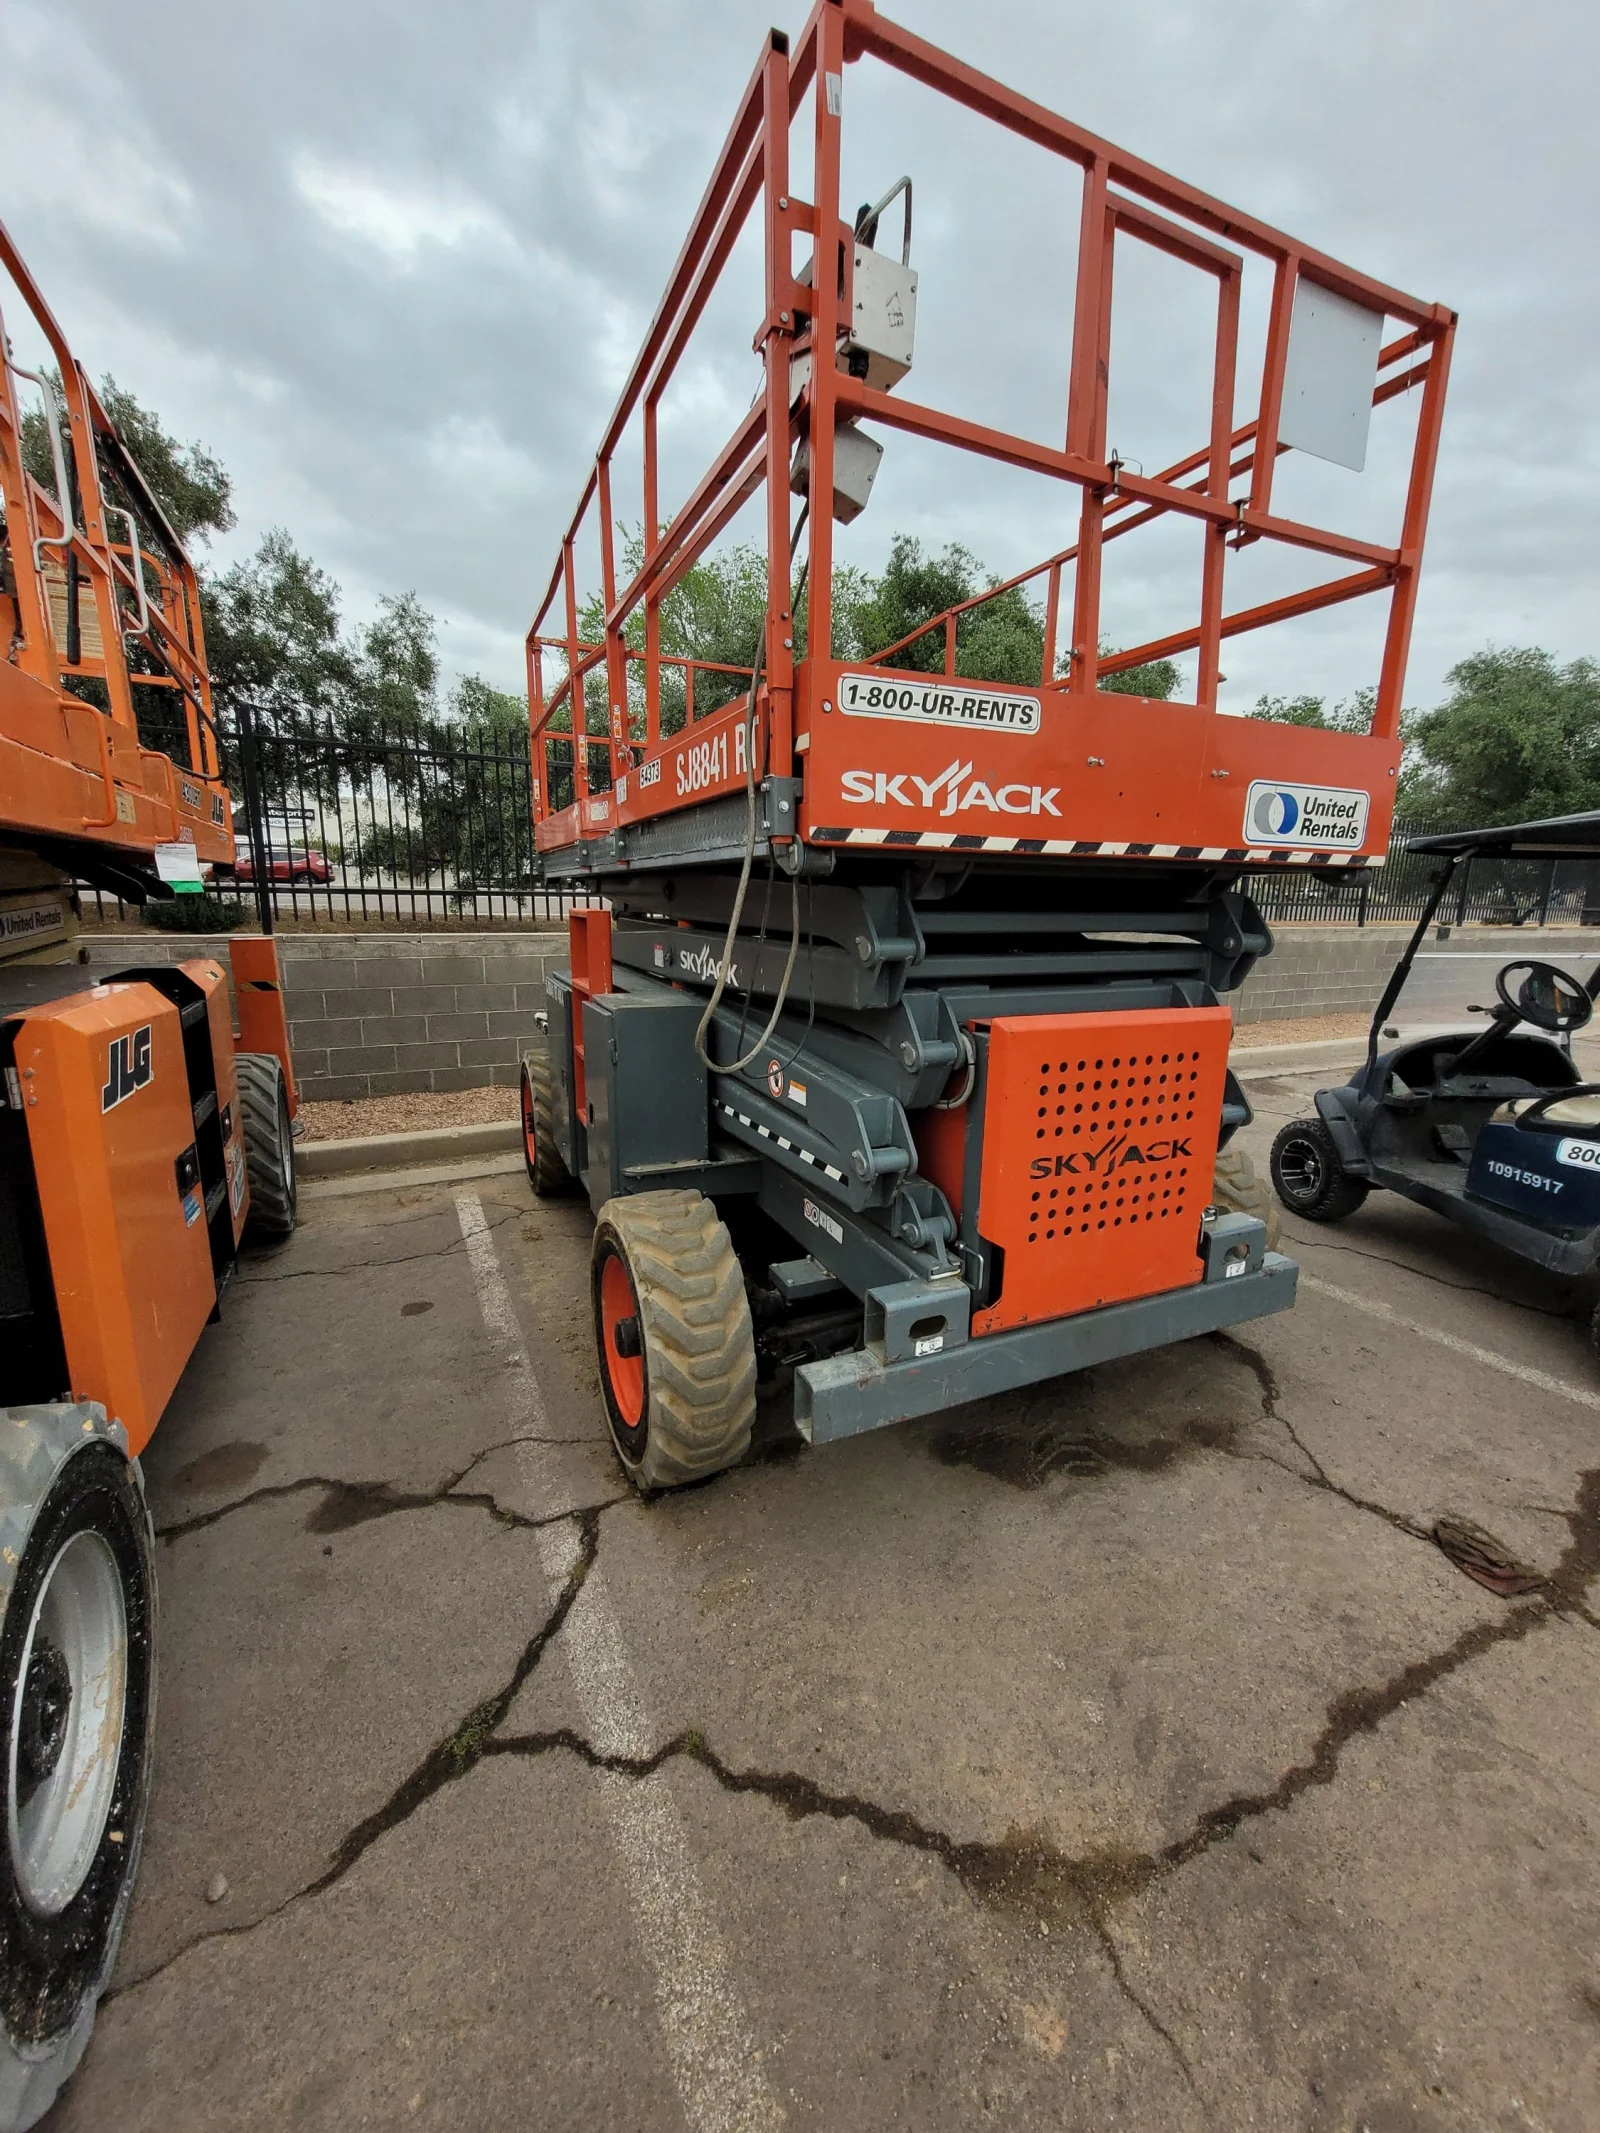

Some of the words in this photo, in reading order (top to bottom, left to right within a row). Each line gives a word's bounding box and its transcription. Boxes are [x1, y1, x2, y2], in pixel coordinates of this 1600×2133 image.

[848, 684, 1034, 725] 1-800-UR-RENTS
[676, 731, 728, 796] SJ8841
[841, 758, 1063, 817] SKYJACK
[1303, 796, 1358, 819] United
[1299, 818, 1358, 840] Rentals
[6, 913, 34, 935] United
[35, 908, 62, 928] Rentals
[102, 1024, 152, 1115] JLG
[1030, 1133, 1193, 1179] SKYJACK
[1487, 1160, 1564, 1194] 10915917
